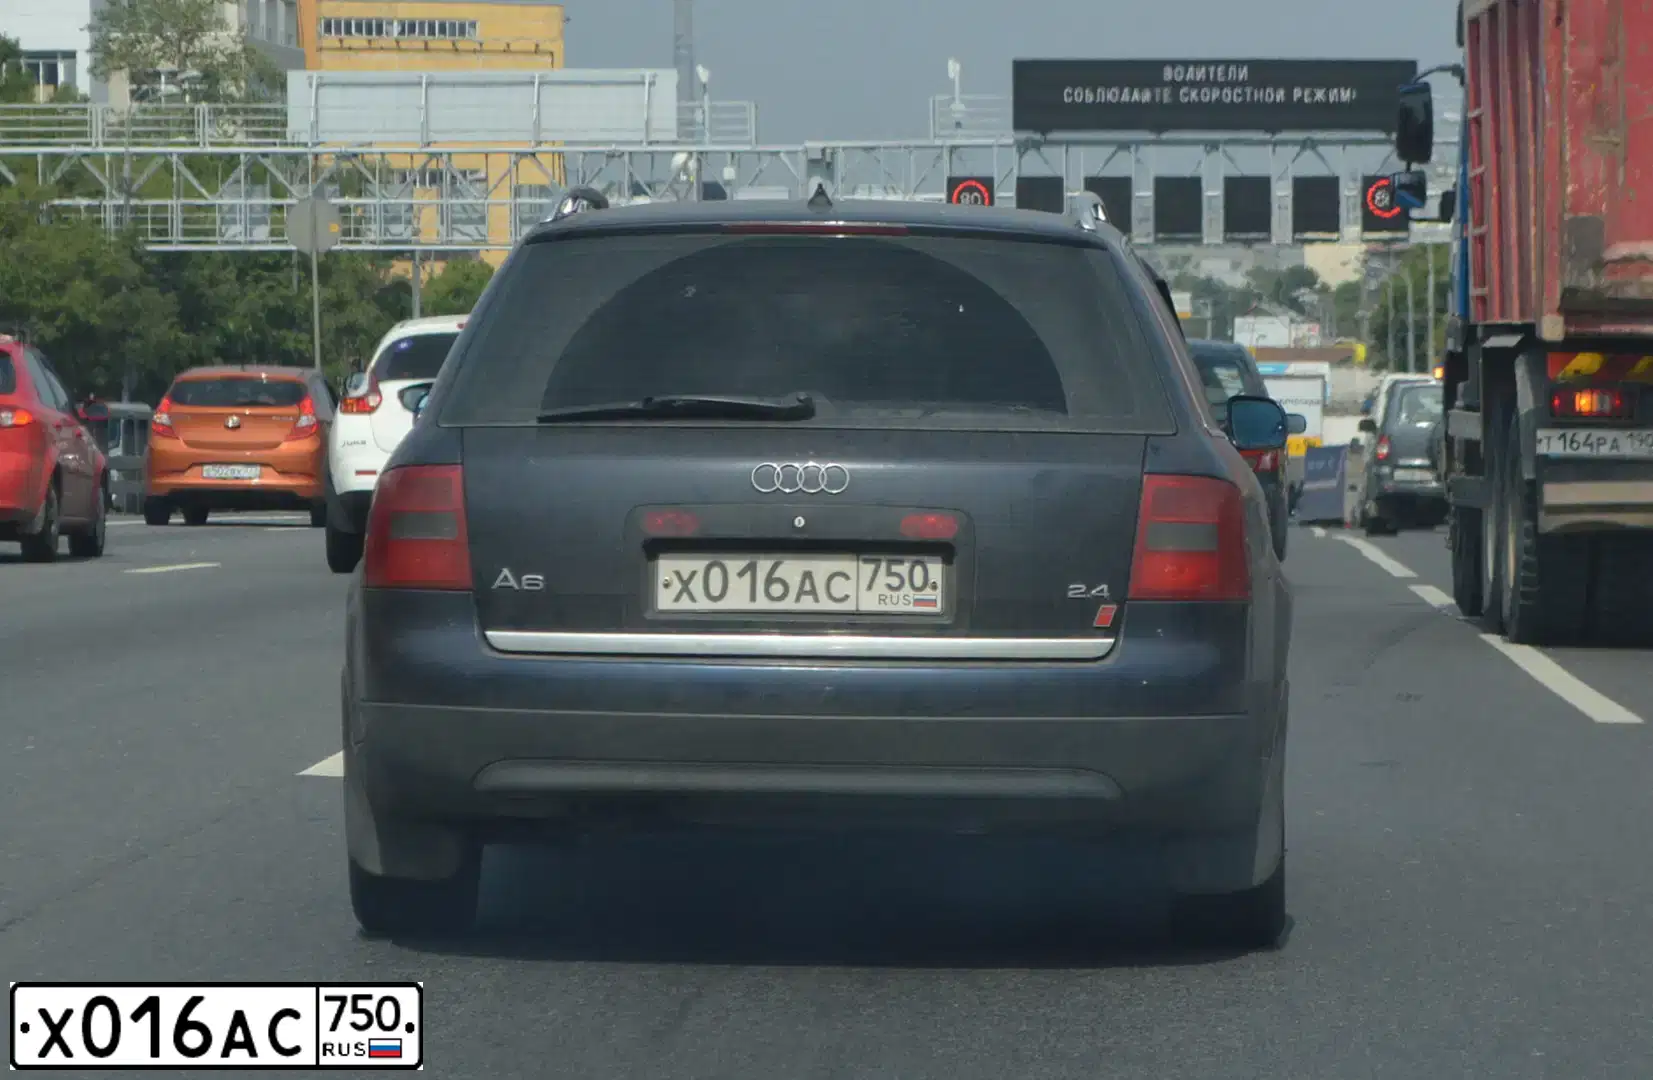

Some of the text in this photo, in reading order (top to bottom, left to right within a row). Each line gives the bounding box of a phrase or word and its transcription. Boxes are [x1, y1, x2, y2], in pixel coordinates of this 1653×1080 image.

[1163, 64, 1249, 82] ВОДИТЕЛИ
[491, 567, 544, 590] A6
[672, 558, 929, 603] Х016АС 750
[878, 594, 911, 606] RUS
